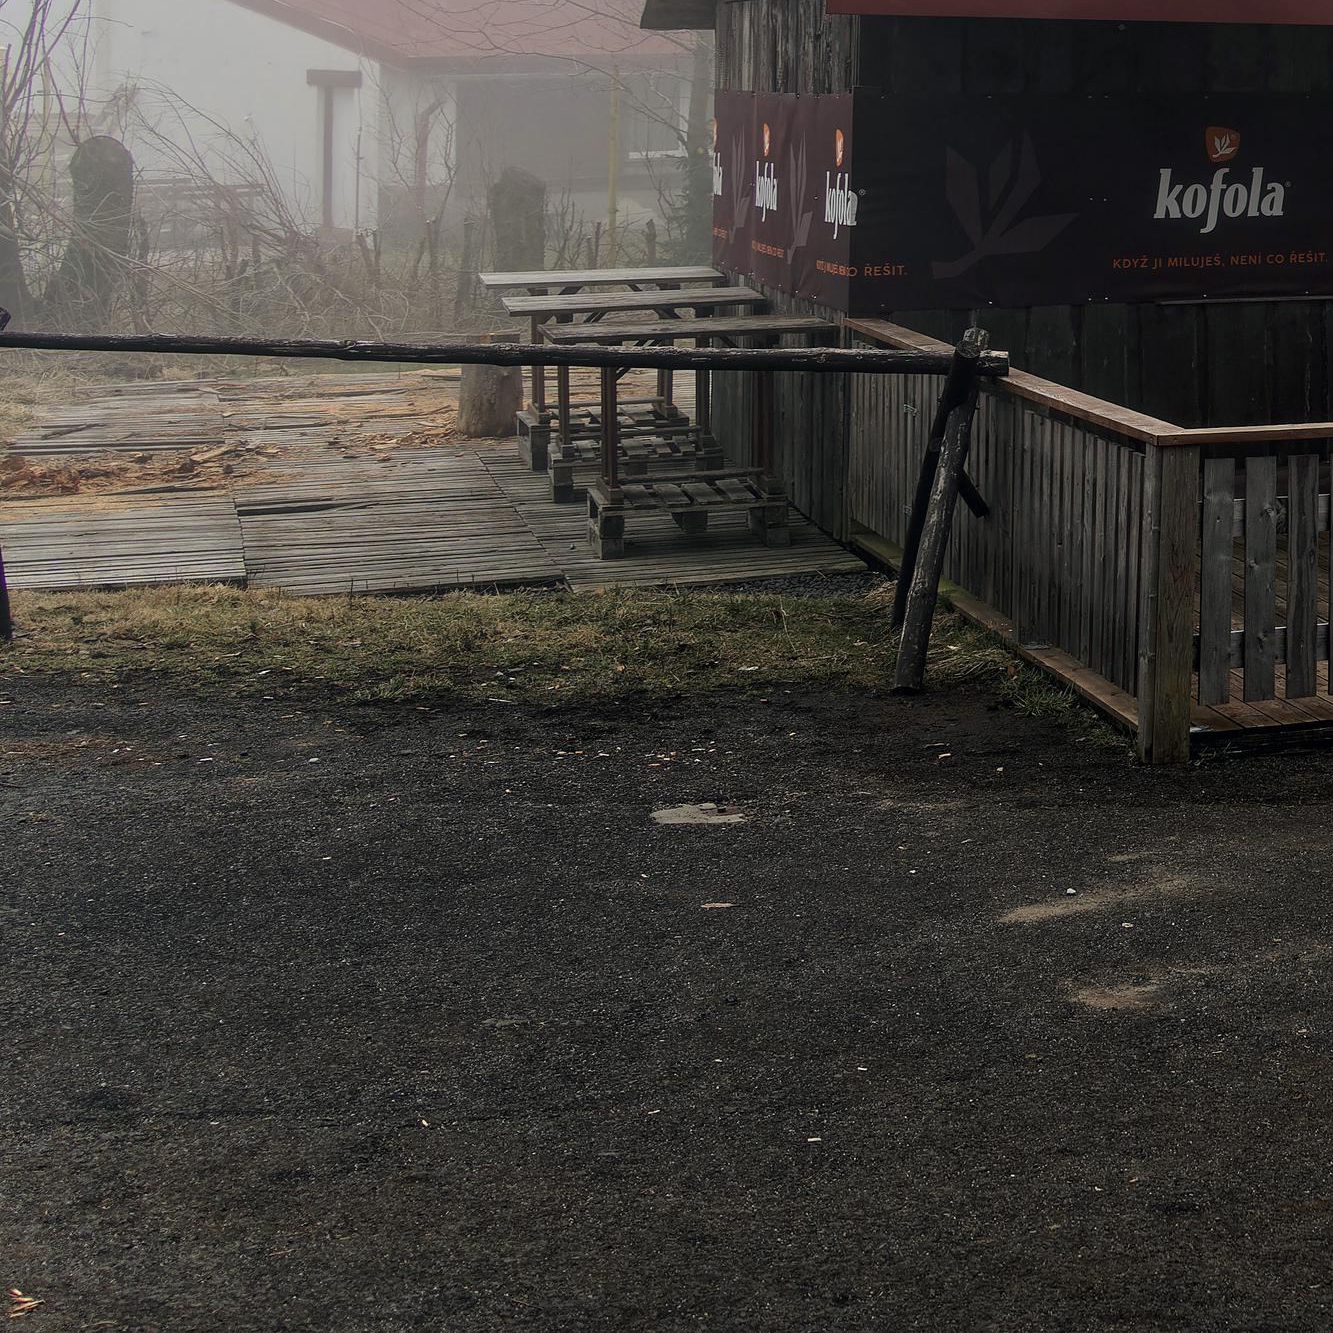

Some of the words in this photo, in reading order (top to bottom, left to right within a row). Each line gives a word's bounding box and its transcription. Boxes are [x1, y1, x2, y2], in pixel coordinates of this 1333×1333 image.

[755, 160, 778, 223] kofola
[824, 171, 858, 240] kofola
[1154, 167, 1285, 233] kofola
[1113, 254, 1148, 269] KDYŽ
[1151, 257, 1162, 270] JI
[1167, 253, 1225, 269] MILUJEŠ,
[1230, 252, 1261, 265] NENÍ
[1266, 254, 1284, 264] CO
[1290, 250, 1328, 264] ŘEŠIT.
